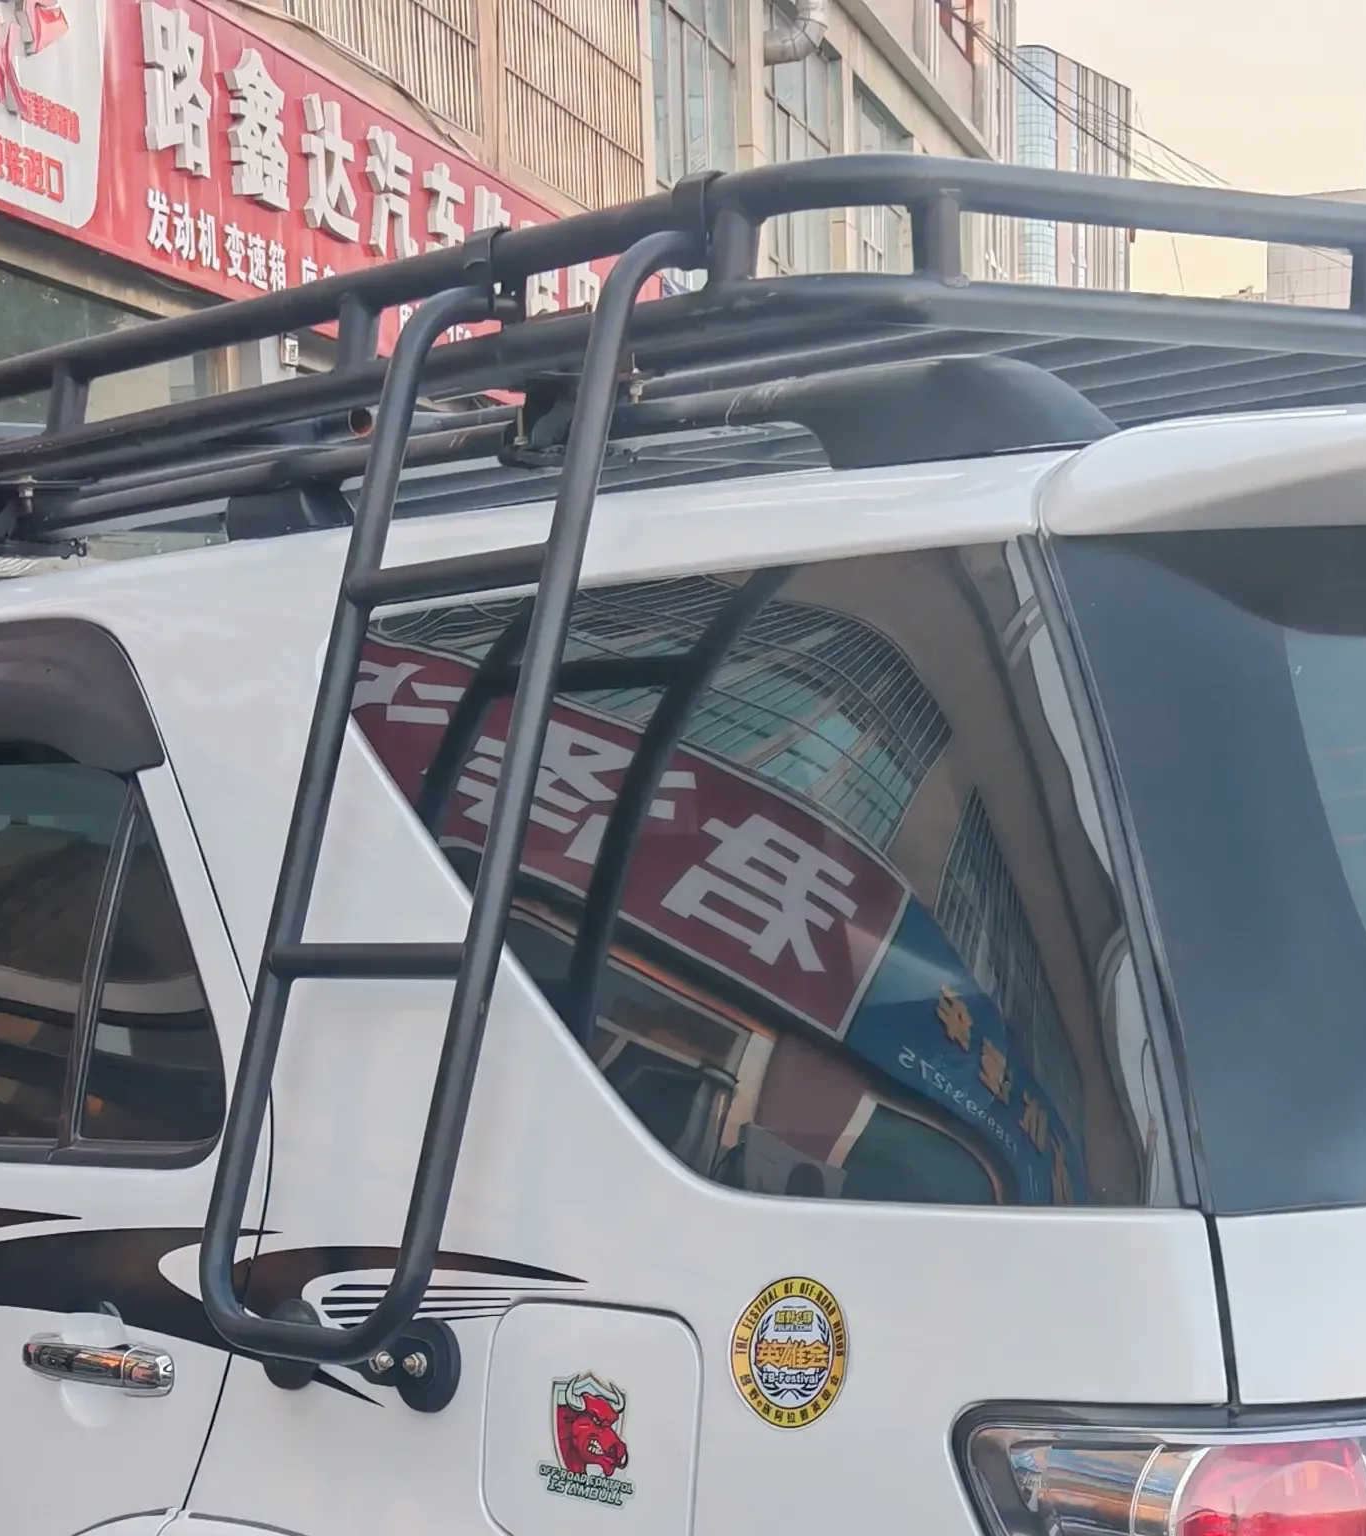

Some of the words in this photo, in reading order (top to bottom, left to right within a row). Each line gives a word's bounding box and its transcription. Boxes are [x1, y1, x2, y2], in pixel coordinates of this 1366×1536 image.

[147, 188, 220, 271] 发动机
[224, 222, 287, 292] 变速箱
[783, 1282, 794, 1295] OF
[799, 1282, 836, 1317] OFF-ROAD
[742, 1287, 779, 1330] FESTIVAL
[735, 1334, 750, 1355] THE
[754, 1337, 830, 1370] 英雄会
[762, 1372, 820, 1385] FB-Festival
[539, 1464, 587, 1484] OFF-ROAD
[588, 1474, 634, 1495] CONTROL
[547, 1480, 566, 1493] IS
